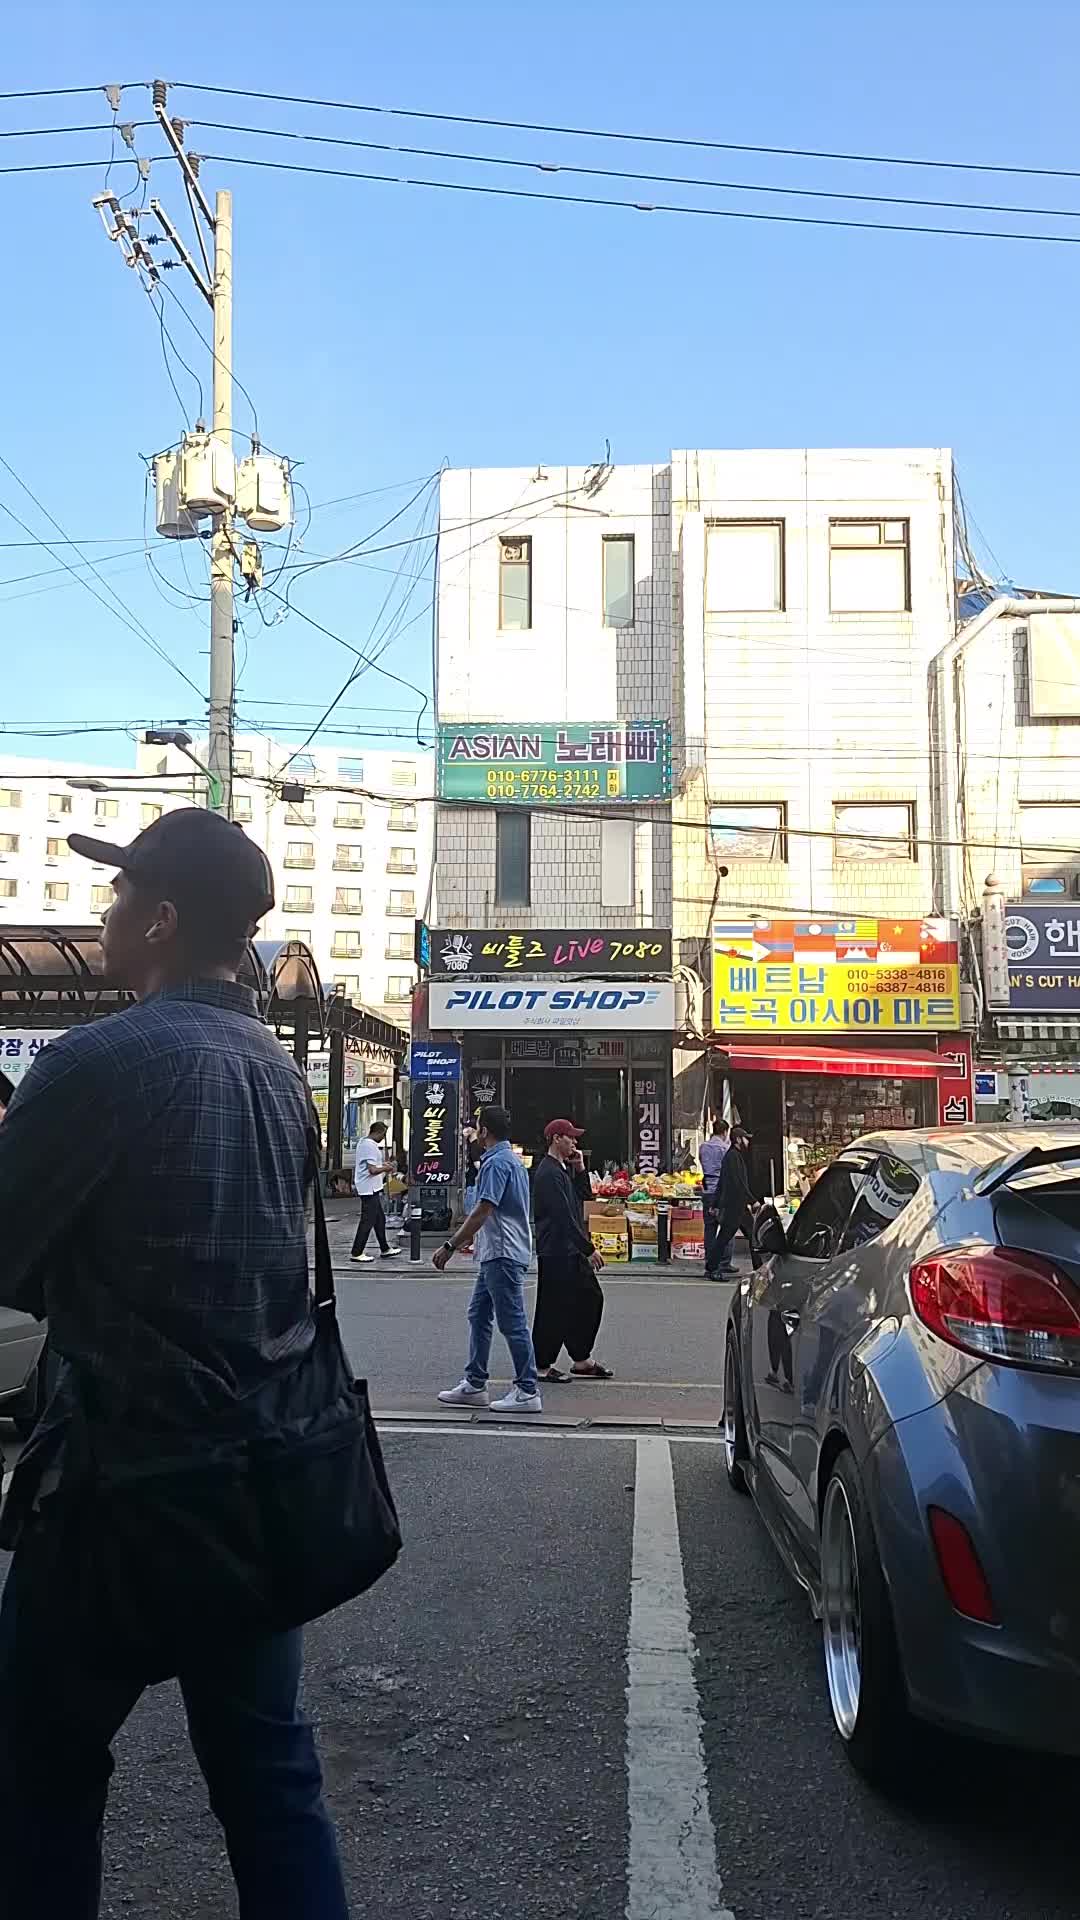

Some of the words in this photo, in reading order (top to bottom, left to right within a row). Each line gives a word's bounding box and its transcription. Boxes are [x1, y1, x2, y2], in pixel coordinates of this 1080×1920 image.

[448, 734, 541, 760] ASIAN
[555, 729, 658, 764] 노래빠
[487, 770, 599, 782] 010-6776-3111
[487, 784, 600, 797] 010-7764-2742
[481, 936, 546, 968] 비틀즈
[554, 937, 604, 965] Live
[609, 941, 663, 961] 7080
[446, 961, 468, 970] 7080
[730, 967, 828, 993] 베트남
[847, 969, 945, 980] 010-5338-4816
[1038, 975, 1064, 987] CUT
[847, 982, 945, 993] 010-6387-4816
[445, 991, 550, 1010] PILOT
[549, 991, 648, 1010] SHOP
[719, 998, 778, 1025] 논곡
[790, 998, 884, 1025] 아시아
[893, 998, 956, 1025] 마트
[0, 1038, 23, 1057] 장
[634, 1080, 657, 1095] 발안
[638, 1103, 660, 1177] 게임장
[425, 1172, 450, 1183] 7080
